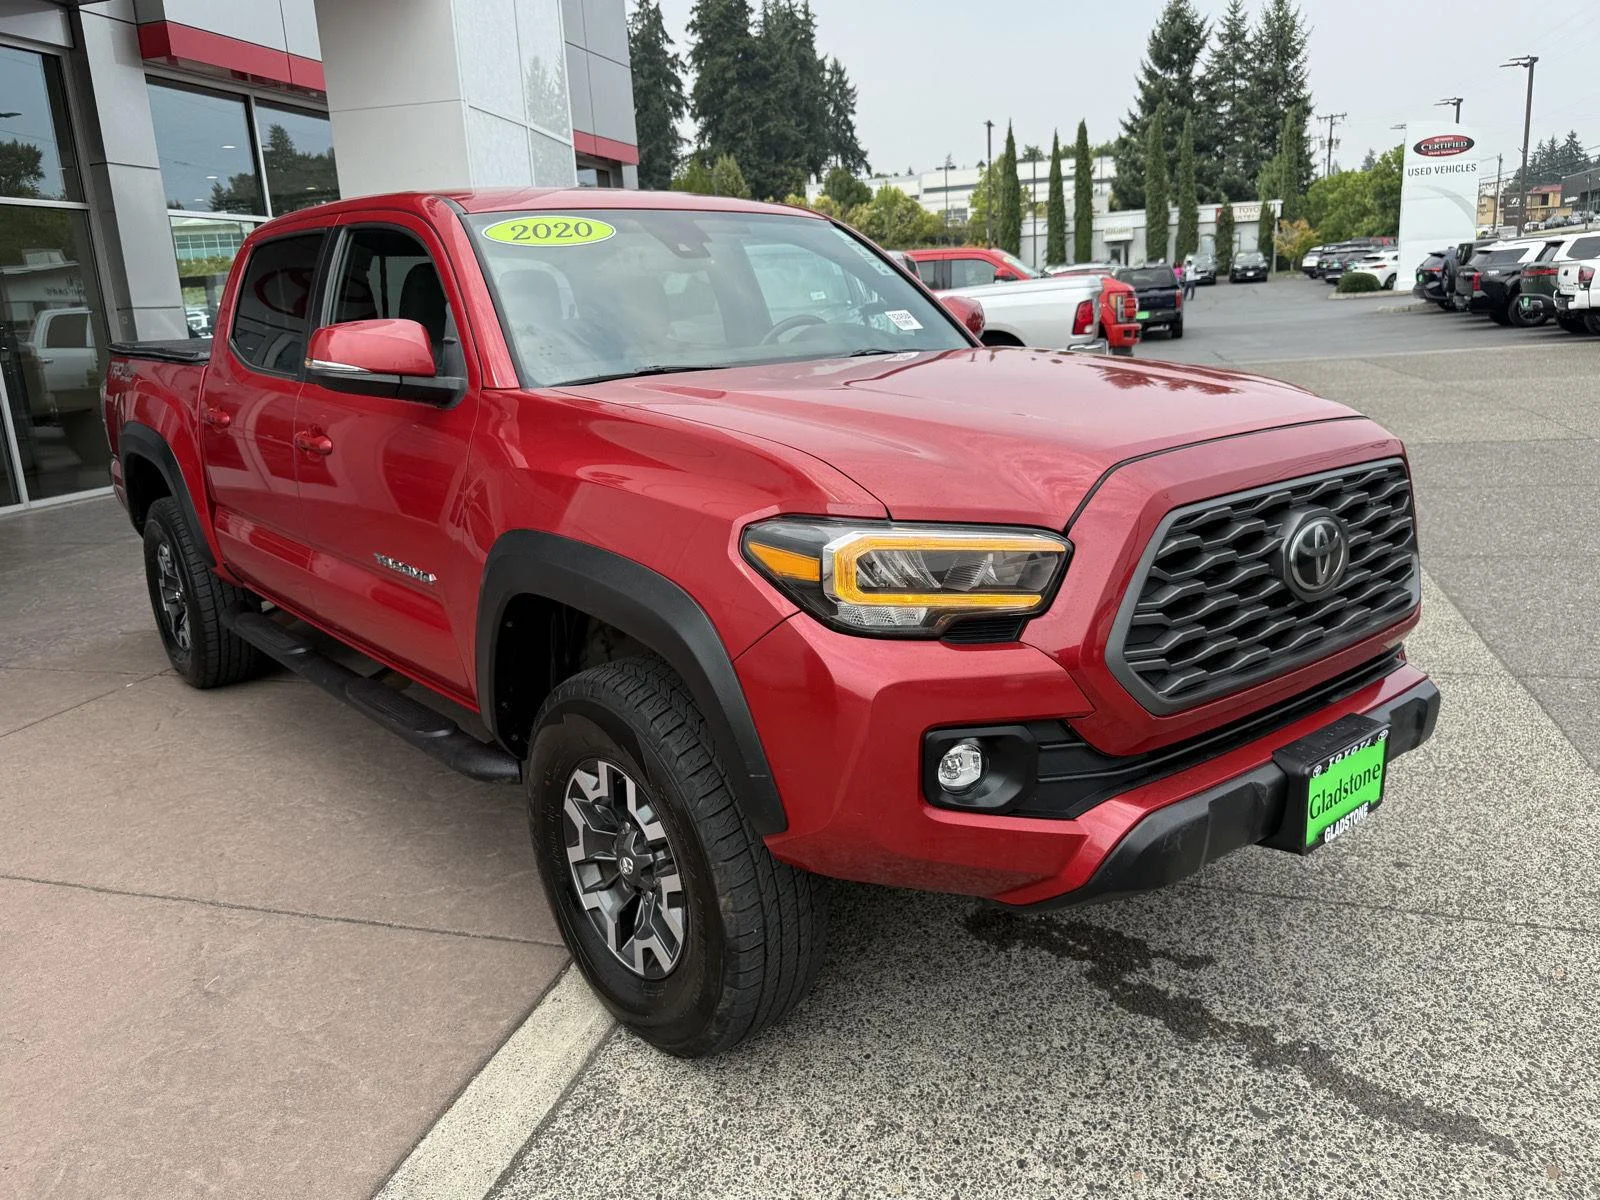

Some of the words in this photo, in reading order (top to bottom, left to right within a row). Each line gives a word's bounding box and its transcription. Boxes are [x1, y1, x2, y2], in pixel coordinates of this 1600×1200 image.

[1421, 141, 1467, 151] CERTIFIED
[1407, 167, 1432, 177] USED
[1435, 164, 1477, 174] VEHICLES
[510, 221, 593, 241] 2020
[1329, 738, 1371, 767] TOYOTA
[1308, 763, 1381, 820] Gladstone
[1323, 802, 1369, 843] GLADSTONE
